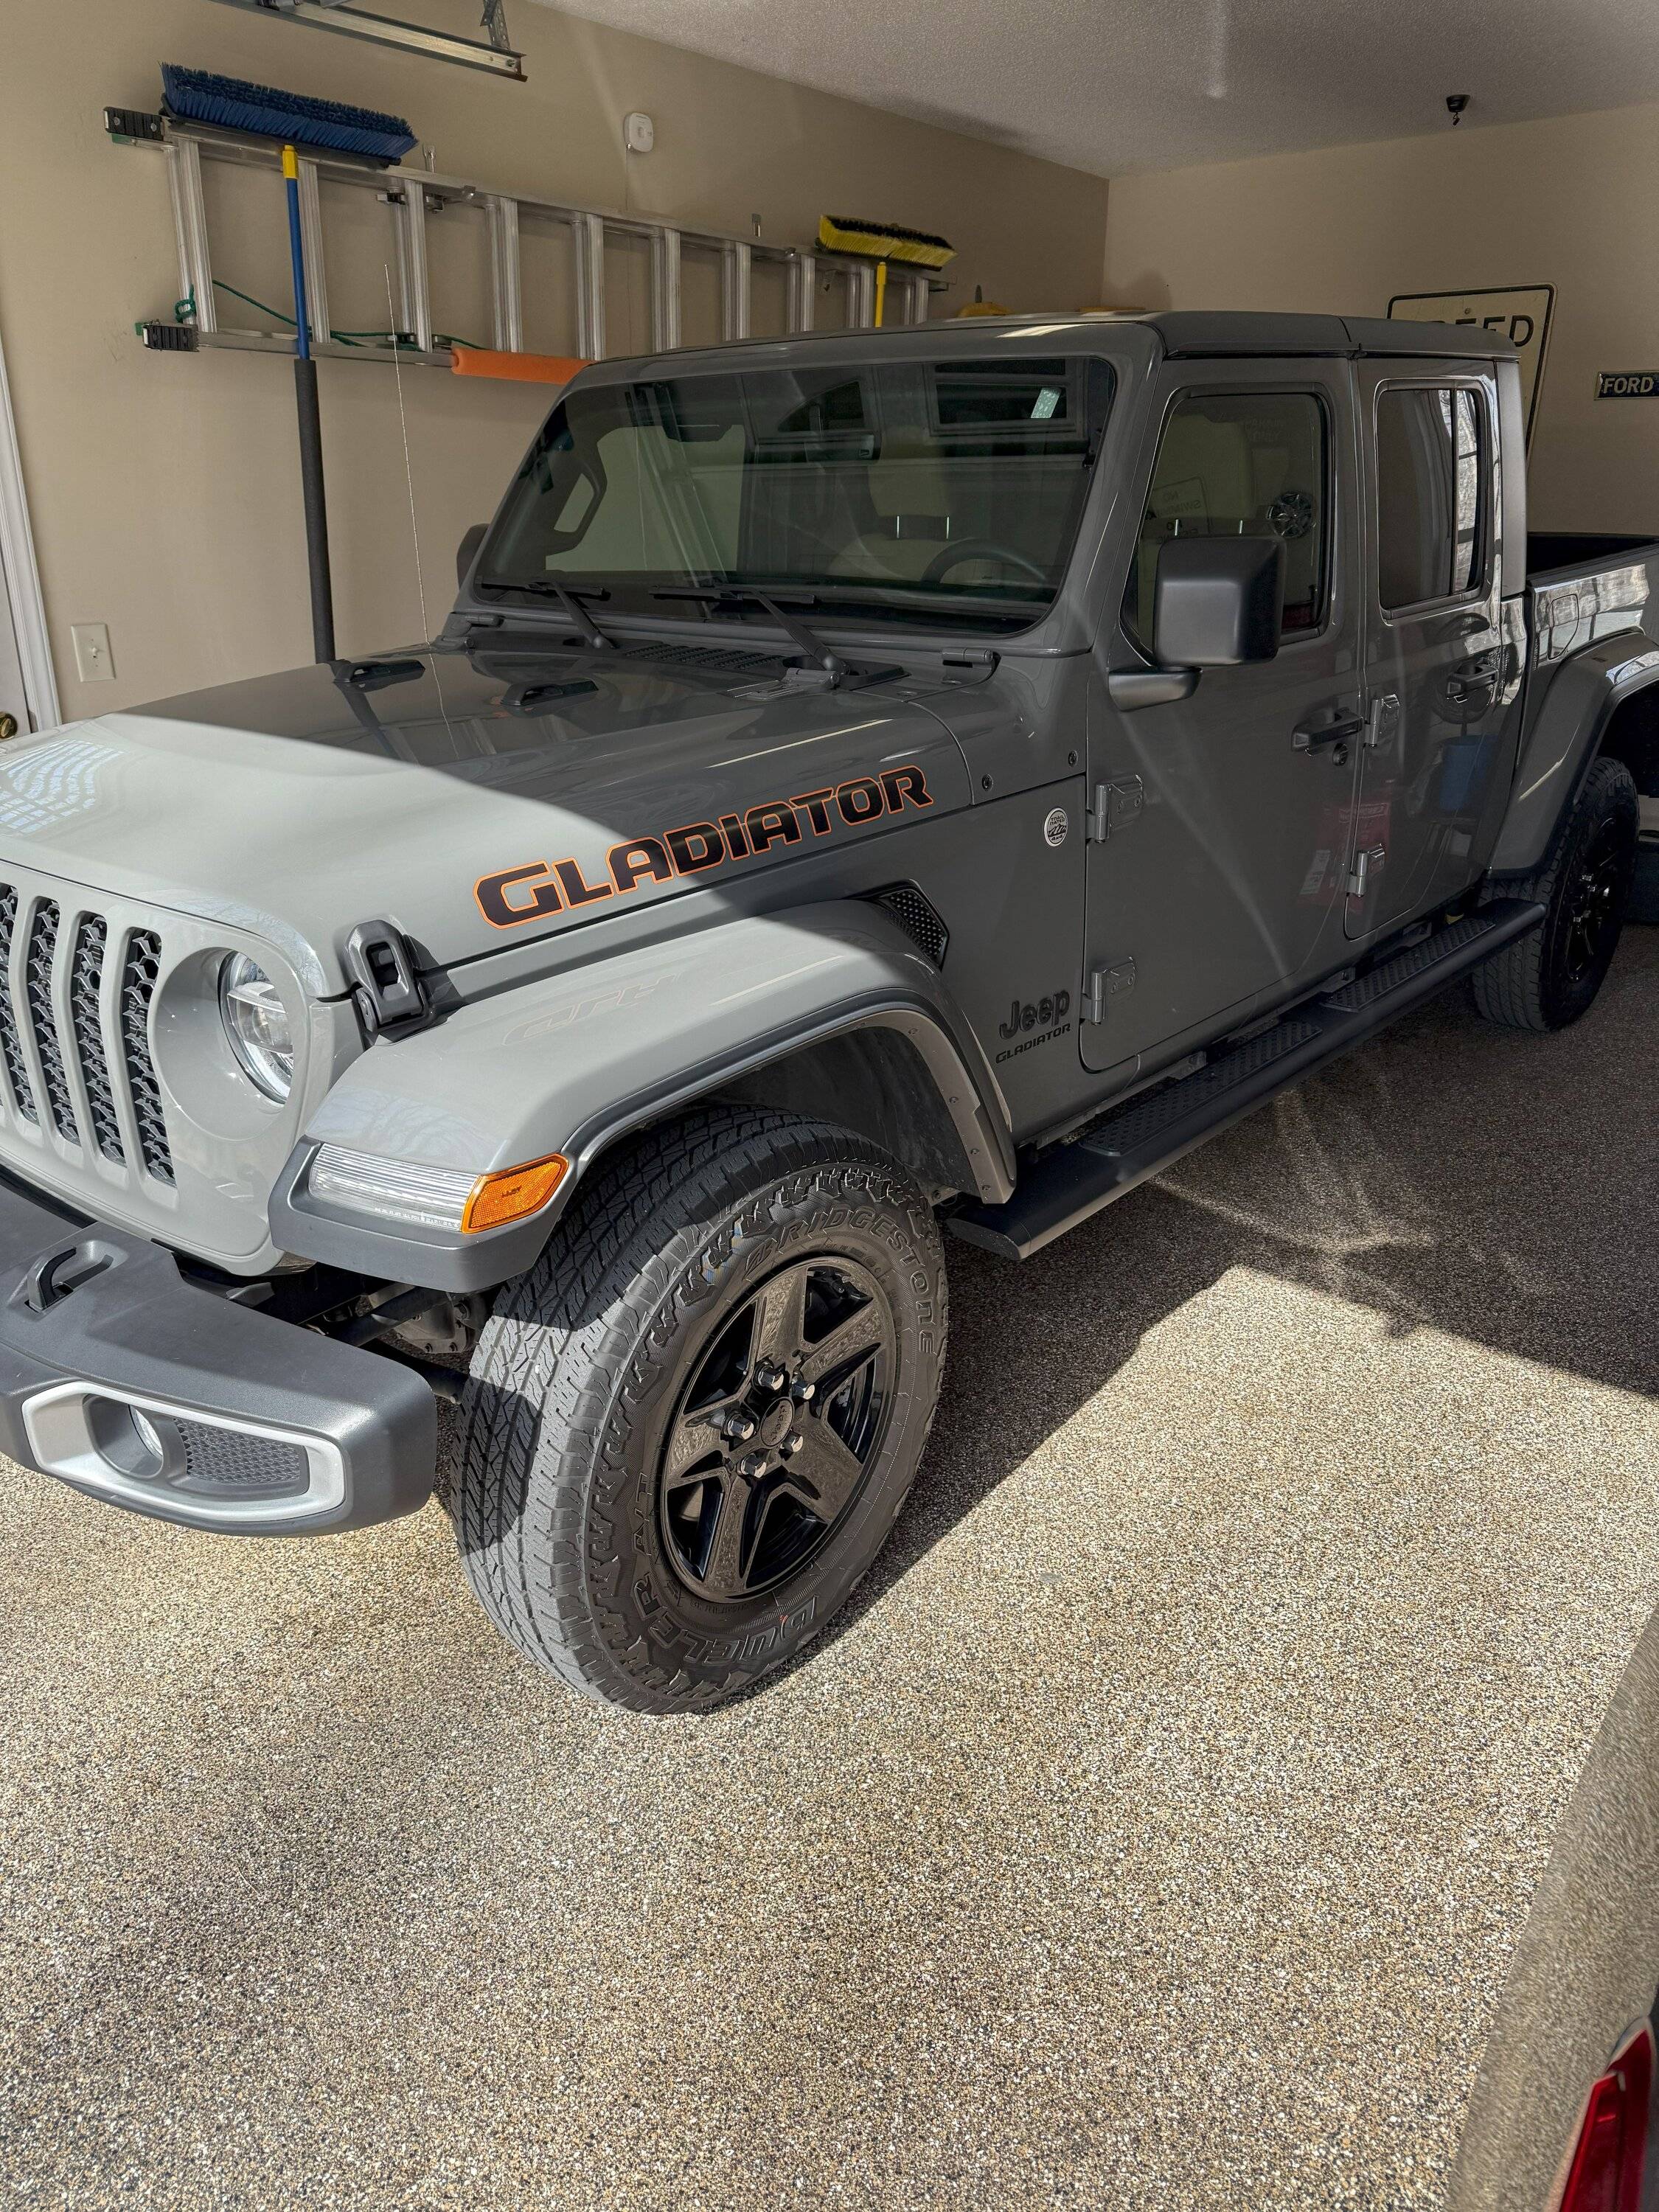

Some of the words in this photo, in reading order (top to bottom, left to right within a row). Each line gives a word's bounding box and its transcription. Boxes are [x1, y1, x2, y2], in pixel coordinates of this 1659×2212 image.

[1603, 376, 1655, 394] FORD
[473, 765, 934, 930] GLADIATOR
[995, 1023, 1071, 1064] GLADIATOR
[999, 989, 1071, 1040] Jeep
[744, 1205, 935, 1354] BRIDGESTONE
[633, 1572, 819, 1666] DUELER
